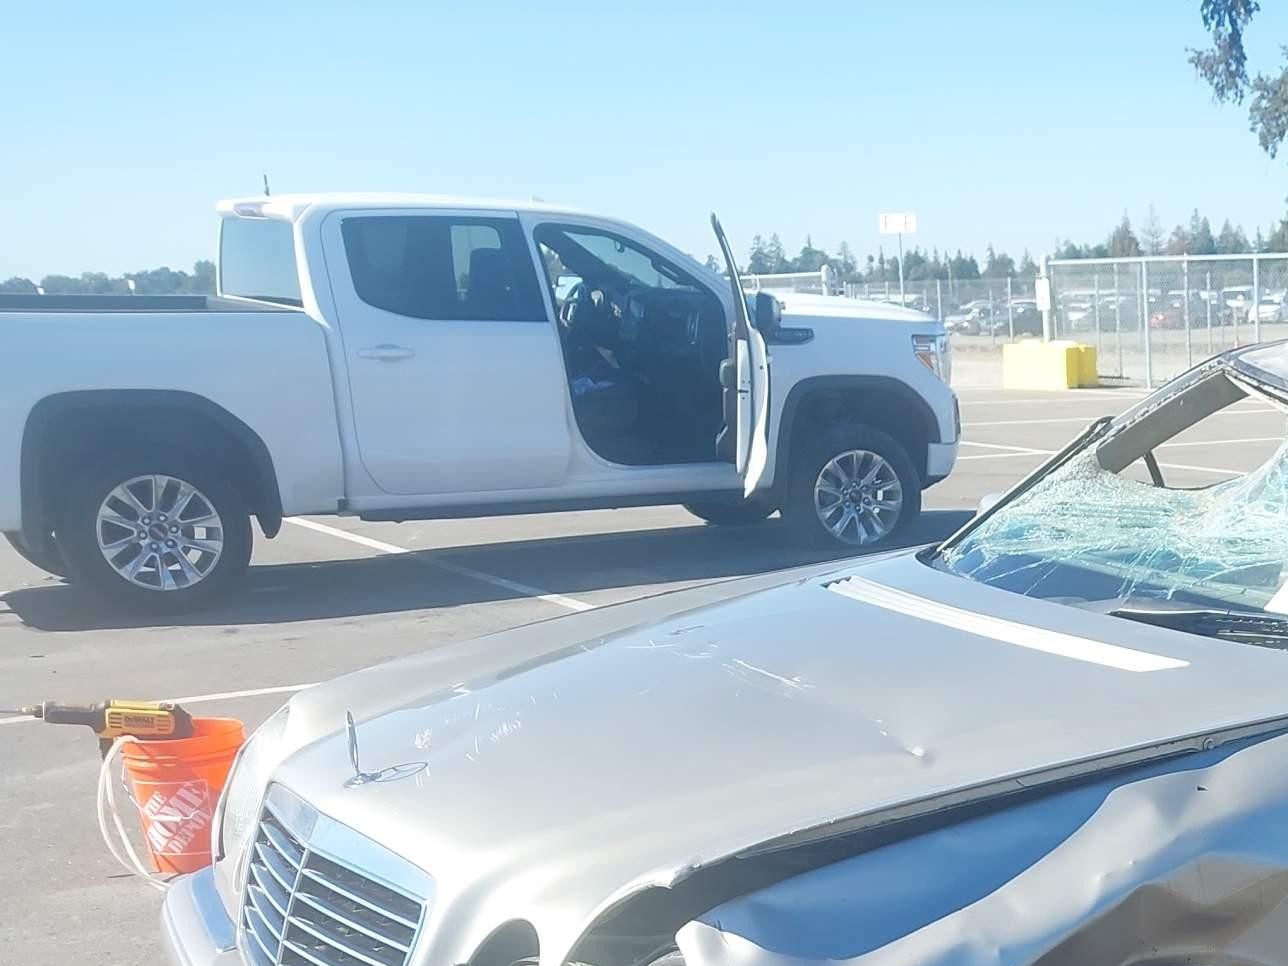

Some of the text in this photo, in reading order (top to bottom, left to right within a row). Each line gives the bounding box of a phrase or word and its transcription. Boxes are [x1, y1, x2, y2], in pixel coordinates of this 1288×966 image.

[143, 790, 168, 817] THE
[147, 782, 207, 852] HOME
[167, 807, 211, 854] DEPOT
